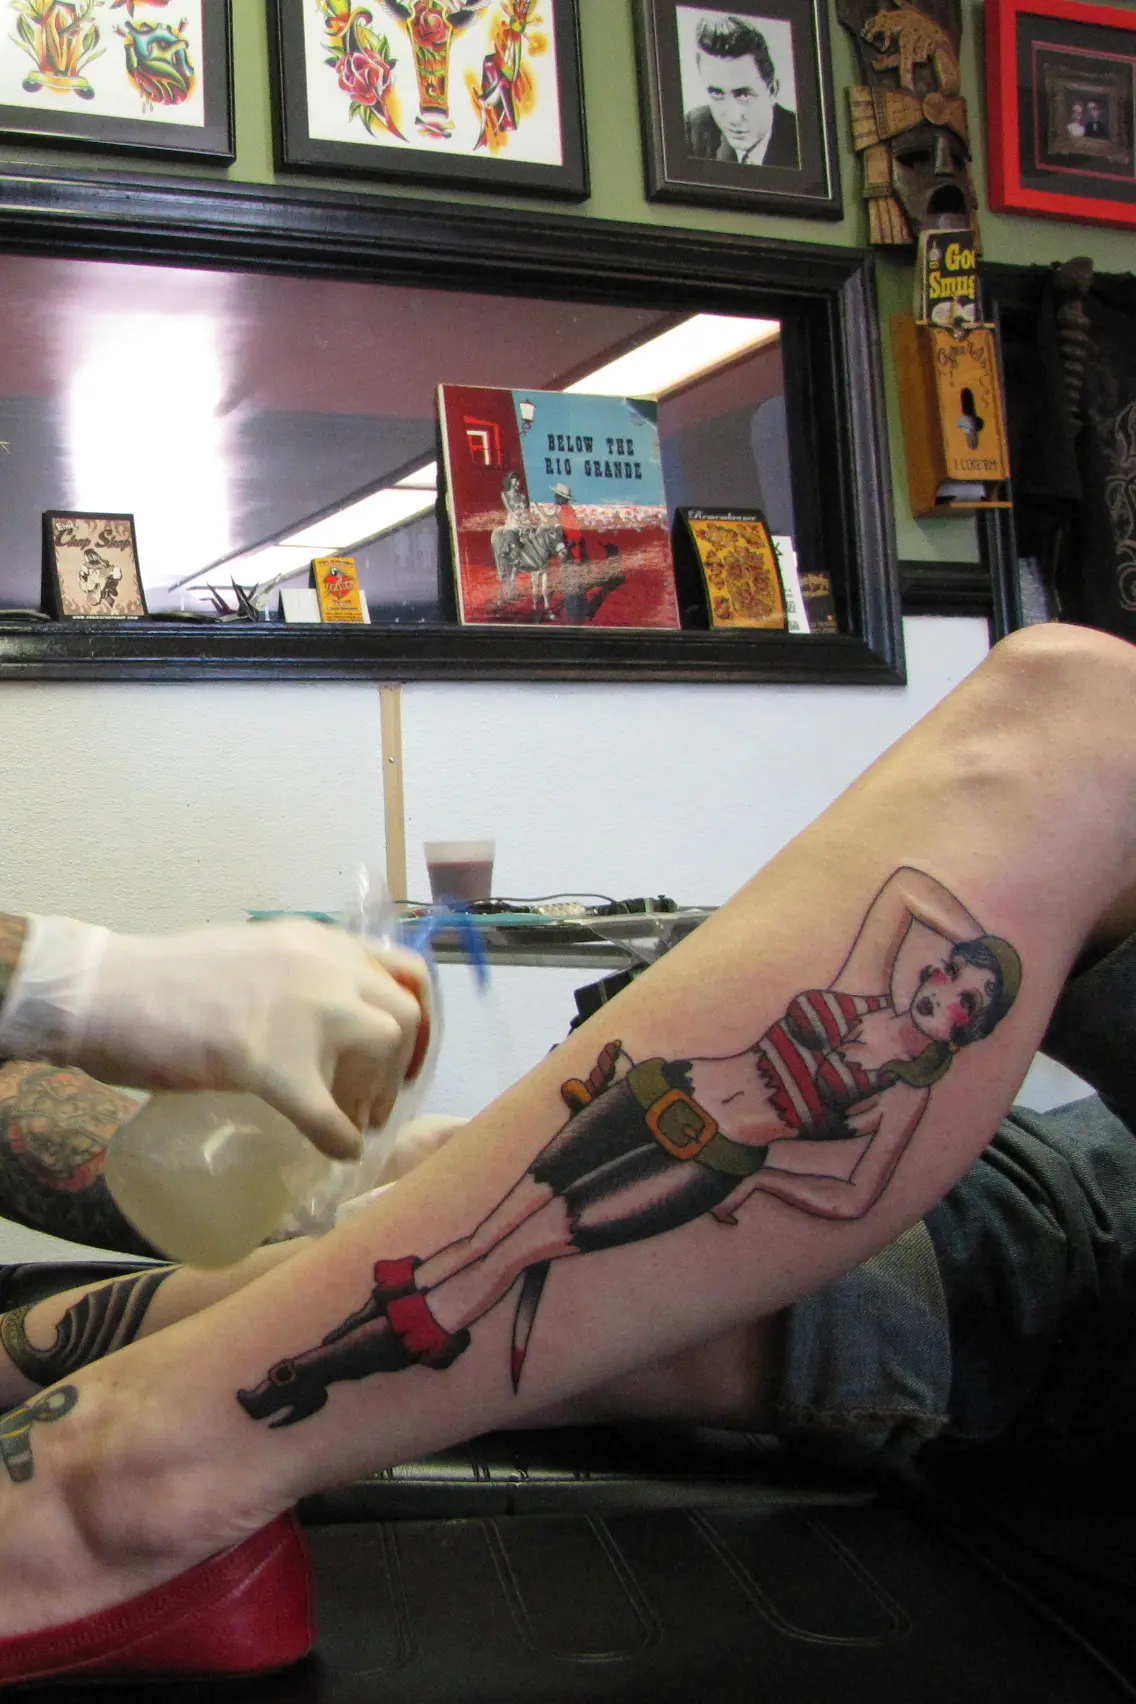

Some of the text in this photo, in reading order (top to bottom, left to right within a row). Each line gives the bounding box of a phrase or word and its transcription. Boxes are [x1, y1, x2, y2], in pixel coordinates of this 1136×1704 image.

[547, 433, 634, 456] BELOW THE
[544, 457, 642, 479] RIO GRANDE
